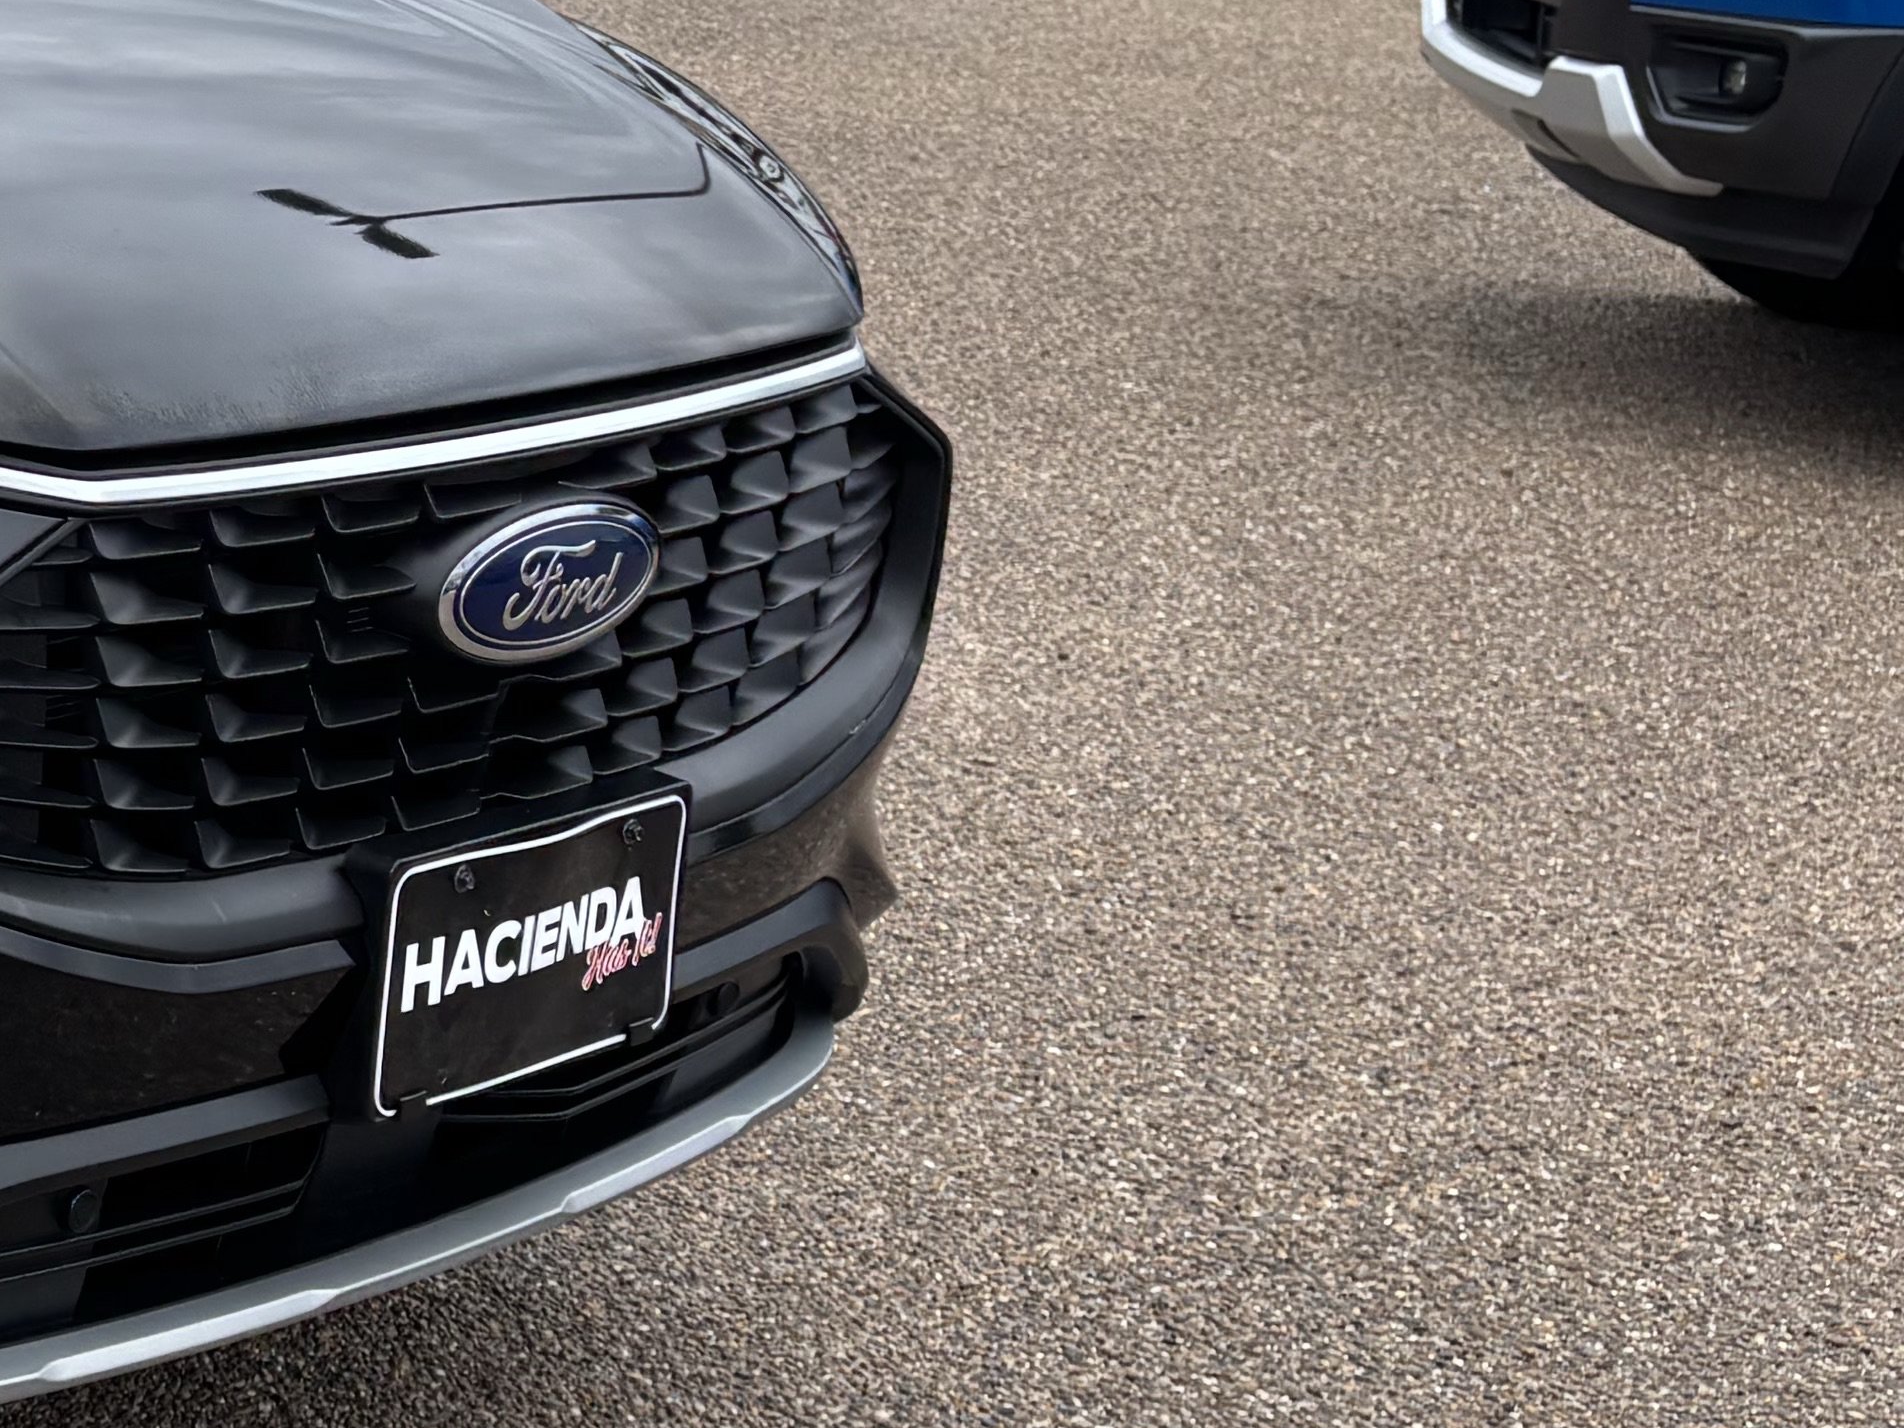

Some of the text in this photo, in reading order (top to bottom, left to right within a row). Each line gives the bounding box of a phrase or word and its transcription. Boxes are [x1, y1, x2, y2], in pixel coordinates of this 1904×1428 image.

[502, 539, 624, 632] Ford
[400, 875, 645, 1013] HACIENDA
[581, 938, 631, 992] Has
